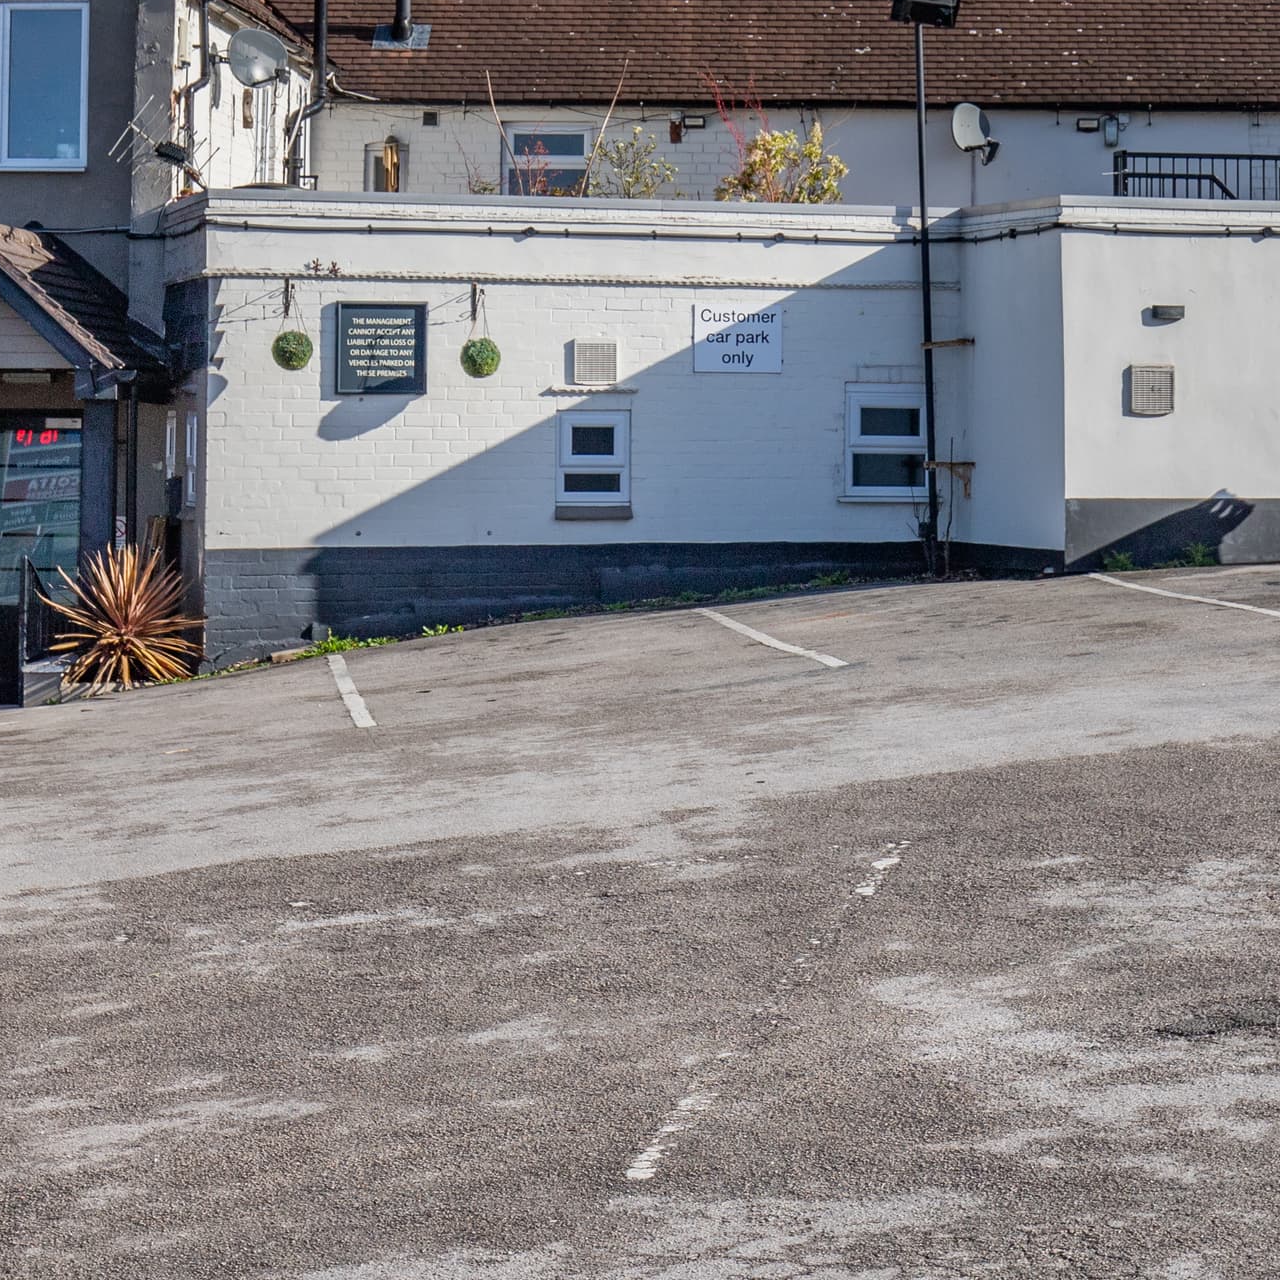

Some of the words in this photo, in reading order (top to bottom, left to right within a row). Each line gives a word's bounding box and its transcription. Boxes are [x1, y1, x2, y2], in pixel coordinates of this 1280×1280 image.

[700, 308, 777, 323] Customer
[352, 317, 365, 325] THE
[366, 317, 413, 325] MANAGEMENT
[348, 328, 376, 336] CANNOT
[376, 328, 400, 336] ACCEPT
[401, 328, 415, 336] ANY
[346, 338, 375, 346] LIABILITY
[376, 338, 390, 346] FOR
[390, 338, 406, 346] LOSS
[706, 332, 732, 343] car
[735, 330, 770, 347] park
[348, 359, 378, 367] VEHICLES
[379, 359, 404, 367] PARKED
[404, 359, 415, 367] ON
[721, 350, 754, 368] only
